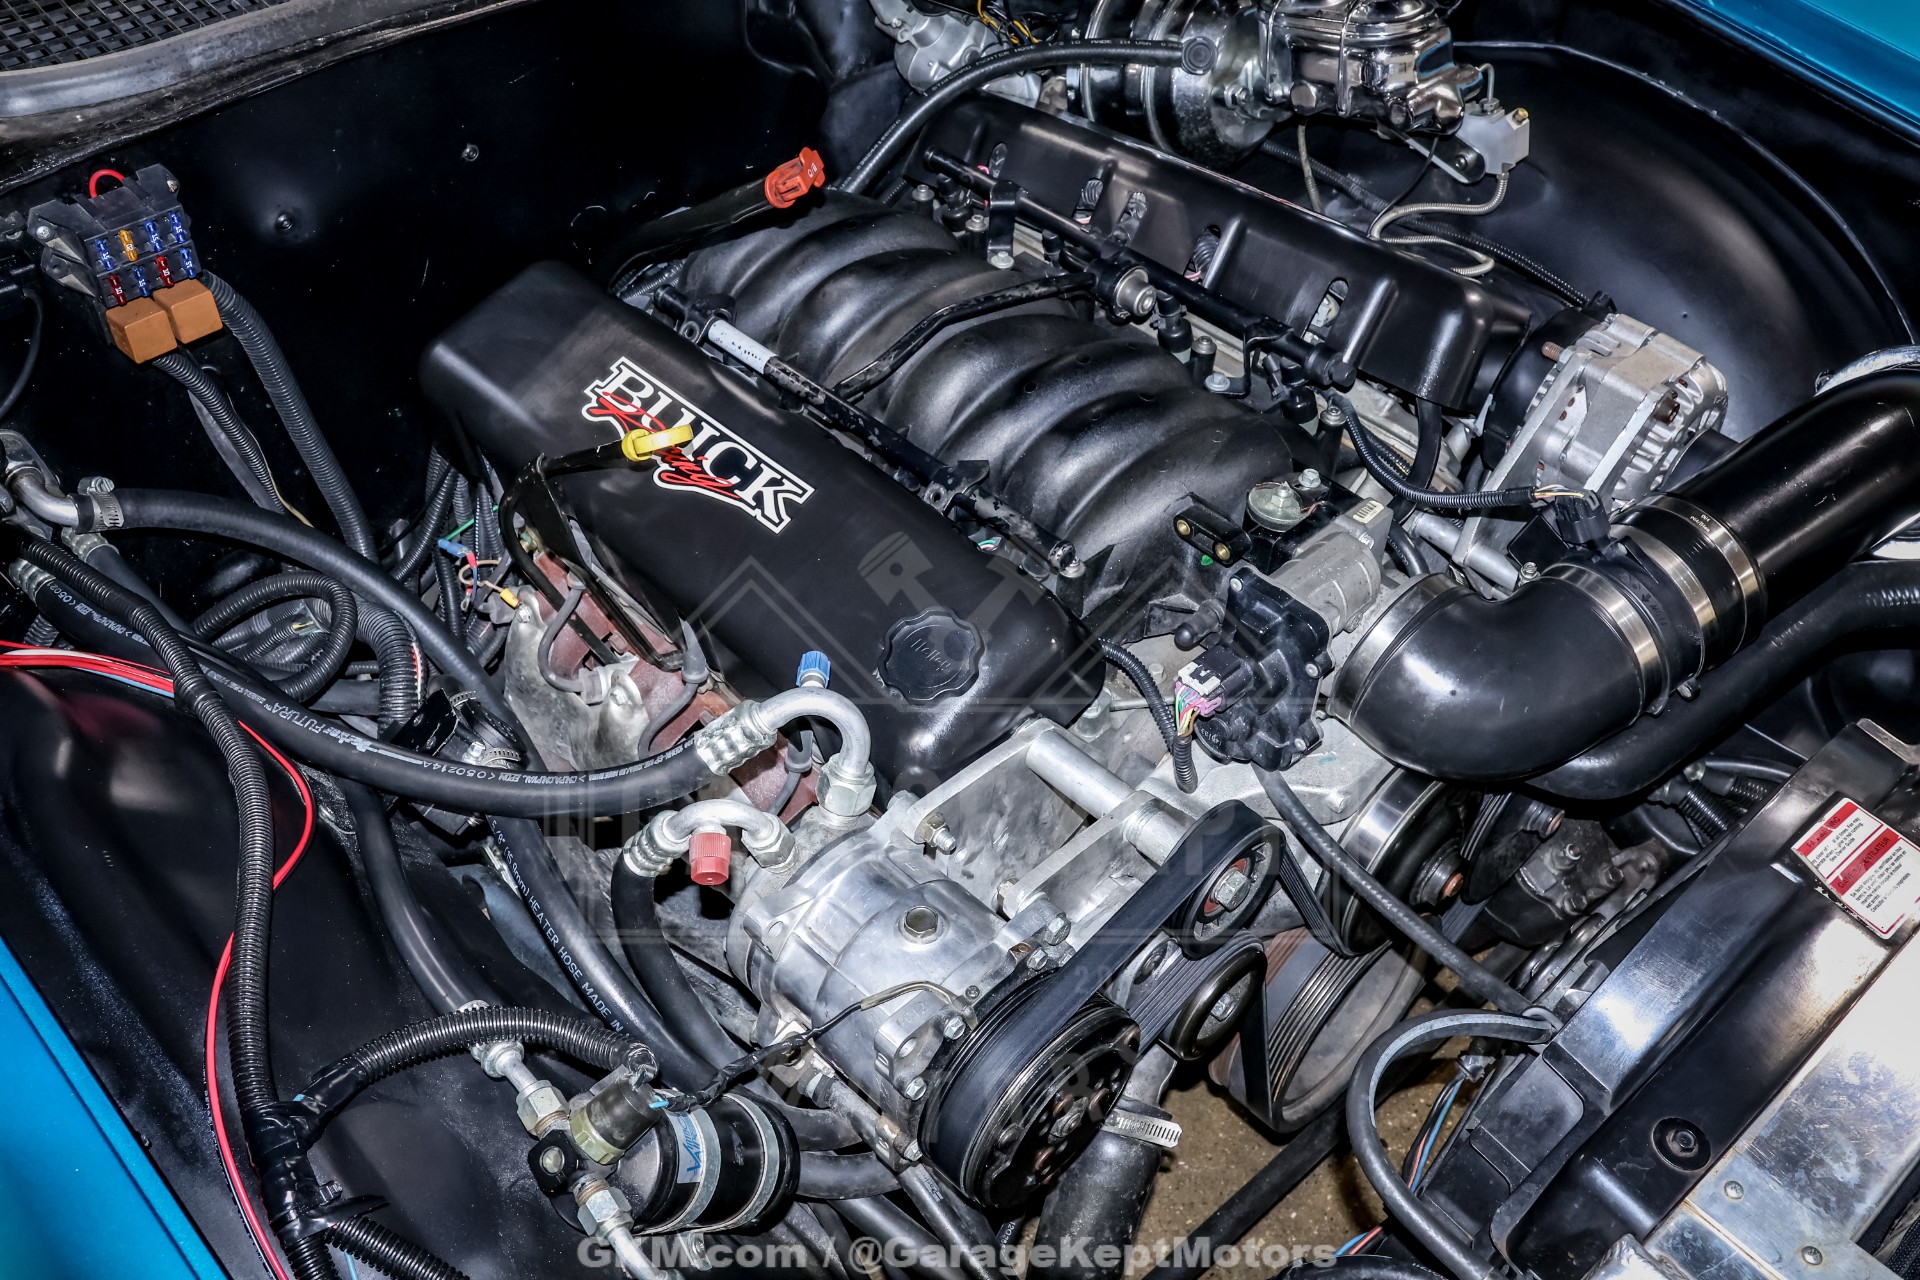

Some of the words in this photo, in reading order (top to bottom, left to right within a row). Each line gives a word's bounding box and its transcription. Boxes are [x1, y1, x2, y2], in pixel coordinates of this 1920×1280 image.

[594, 365, 804, 523] BUICK
[528, 895, 560, 948] HEATER
[557, 946, 583, 982] HOSE
[581, 981, 612, 1018] MADE
[610, 1018, 625, 1033] IN
